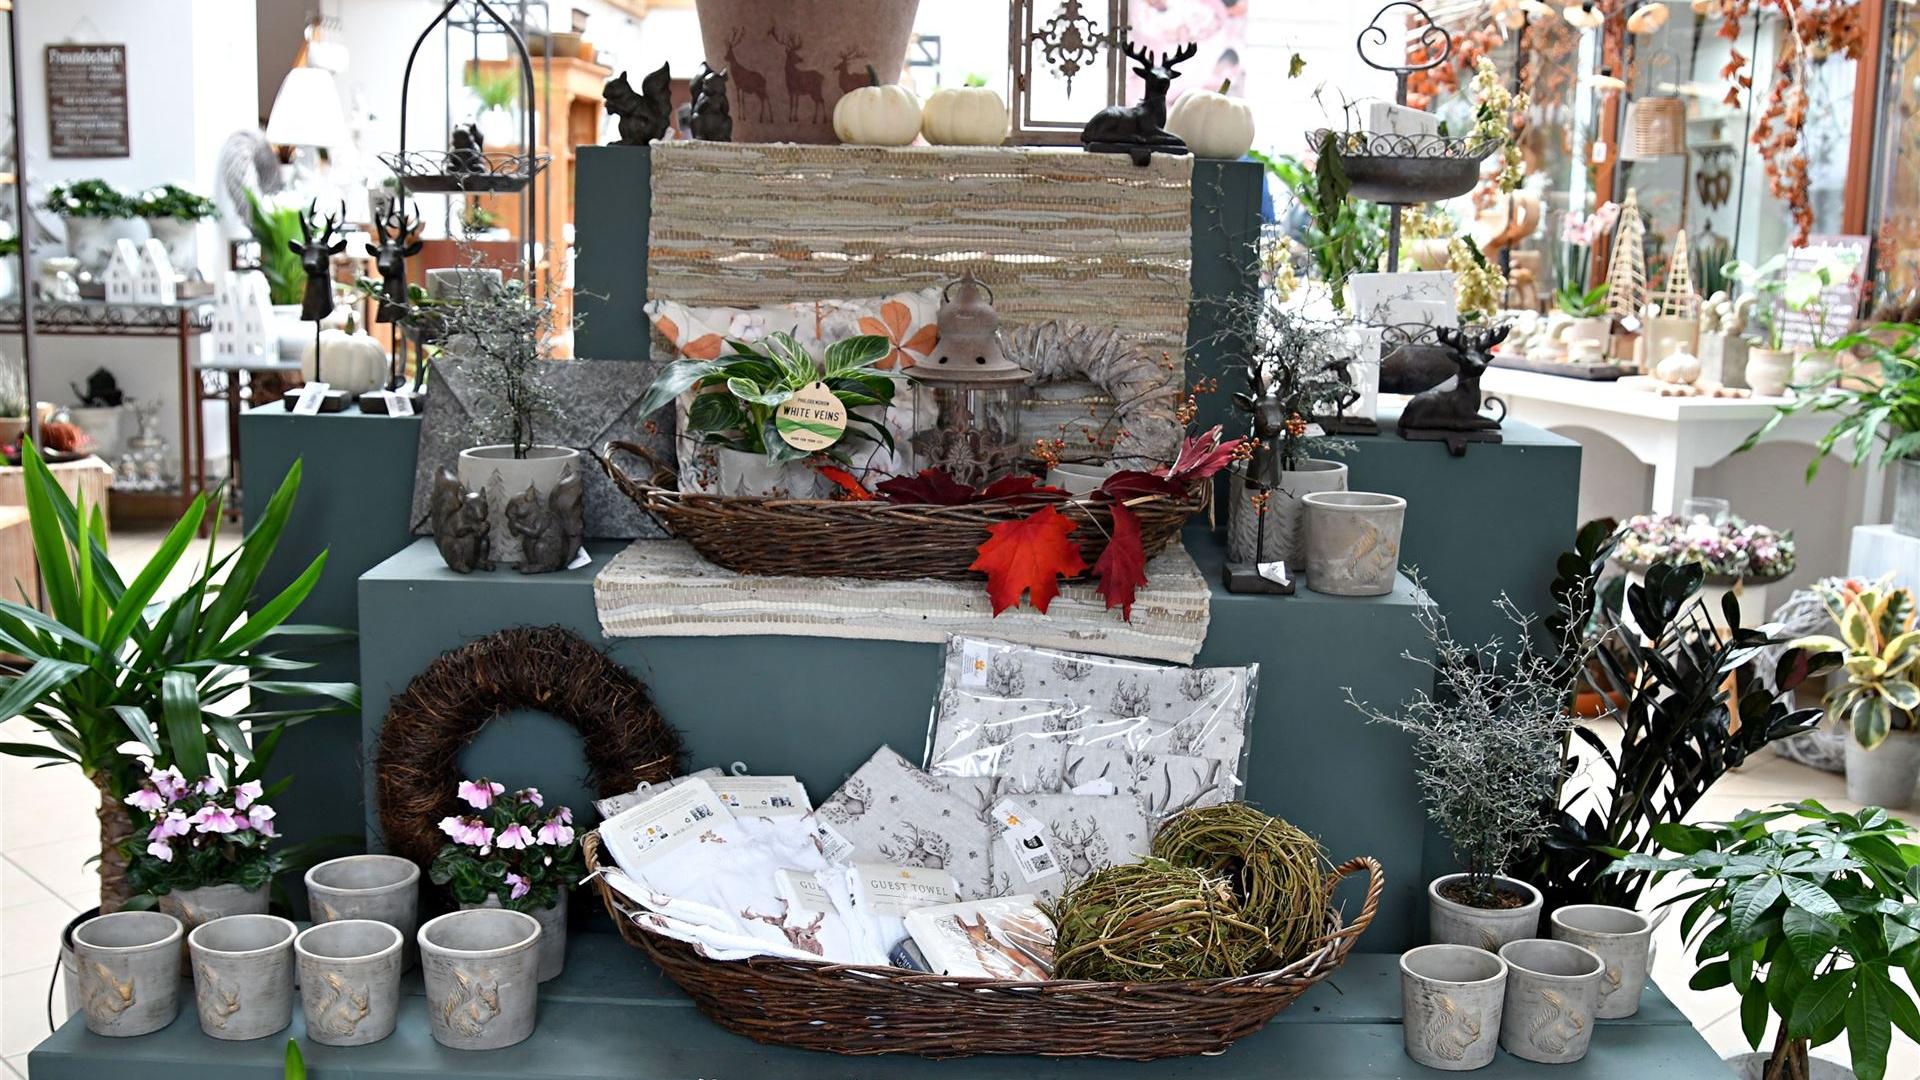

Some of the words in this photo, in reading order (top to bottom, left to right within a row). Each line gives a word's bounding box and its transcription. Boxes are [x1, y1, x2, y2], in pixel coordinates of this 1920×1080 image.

[783, 406, 811, 418] WHITE
[814, 410, 840, 421] VEINS
[800, 880, 824, 892] GUE
[870, 880, 906, 891] GUEST
[911, 883, 949, 896] TOWEL
